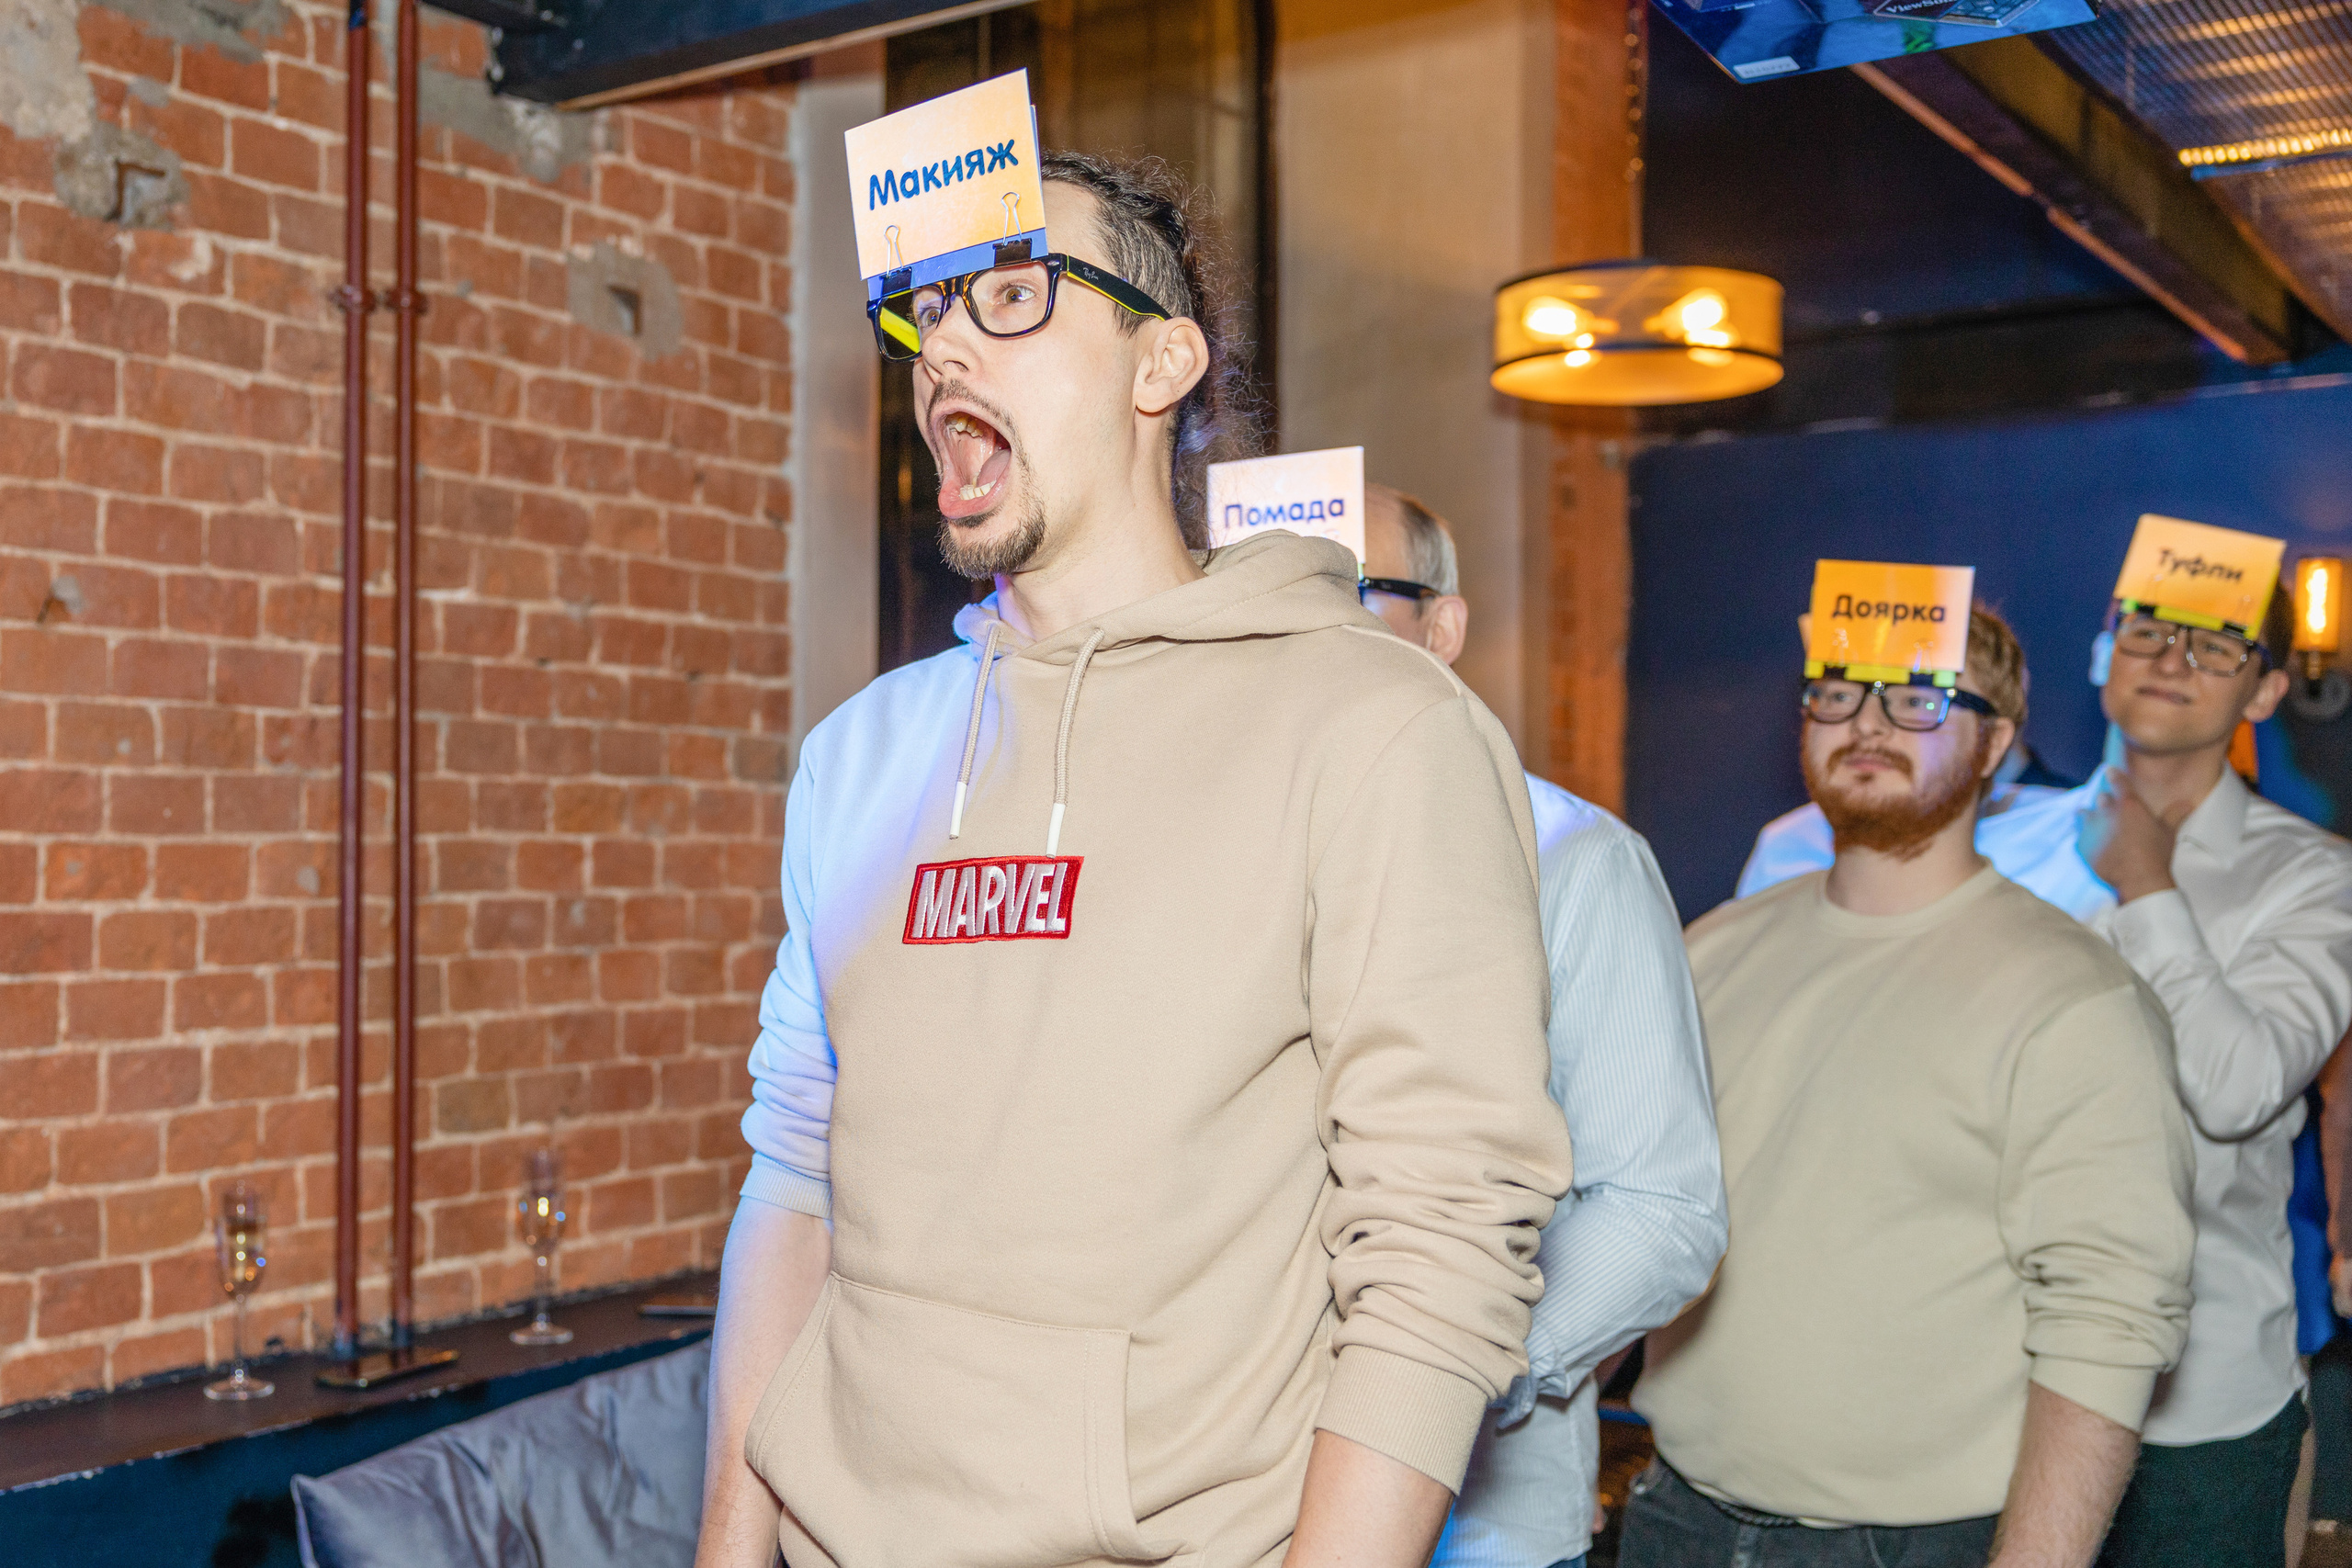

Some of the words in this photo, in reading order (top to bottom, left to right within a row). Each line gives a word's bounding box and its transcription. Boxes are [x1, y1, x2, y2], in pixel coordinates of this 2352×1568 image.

[868, 139, 1019, 210] Макияж
[1225, 499, 1345, 528] Помада
[1832, 594, 1946, 626] Доярка
[911, 862, 1069, 939] MARVEL
